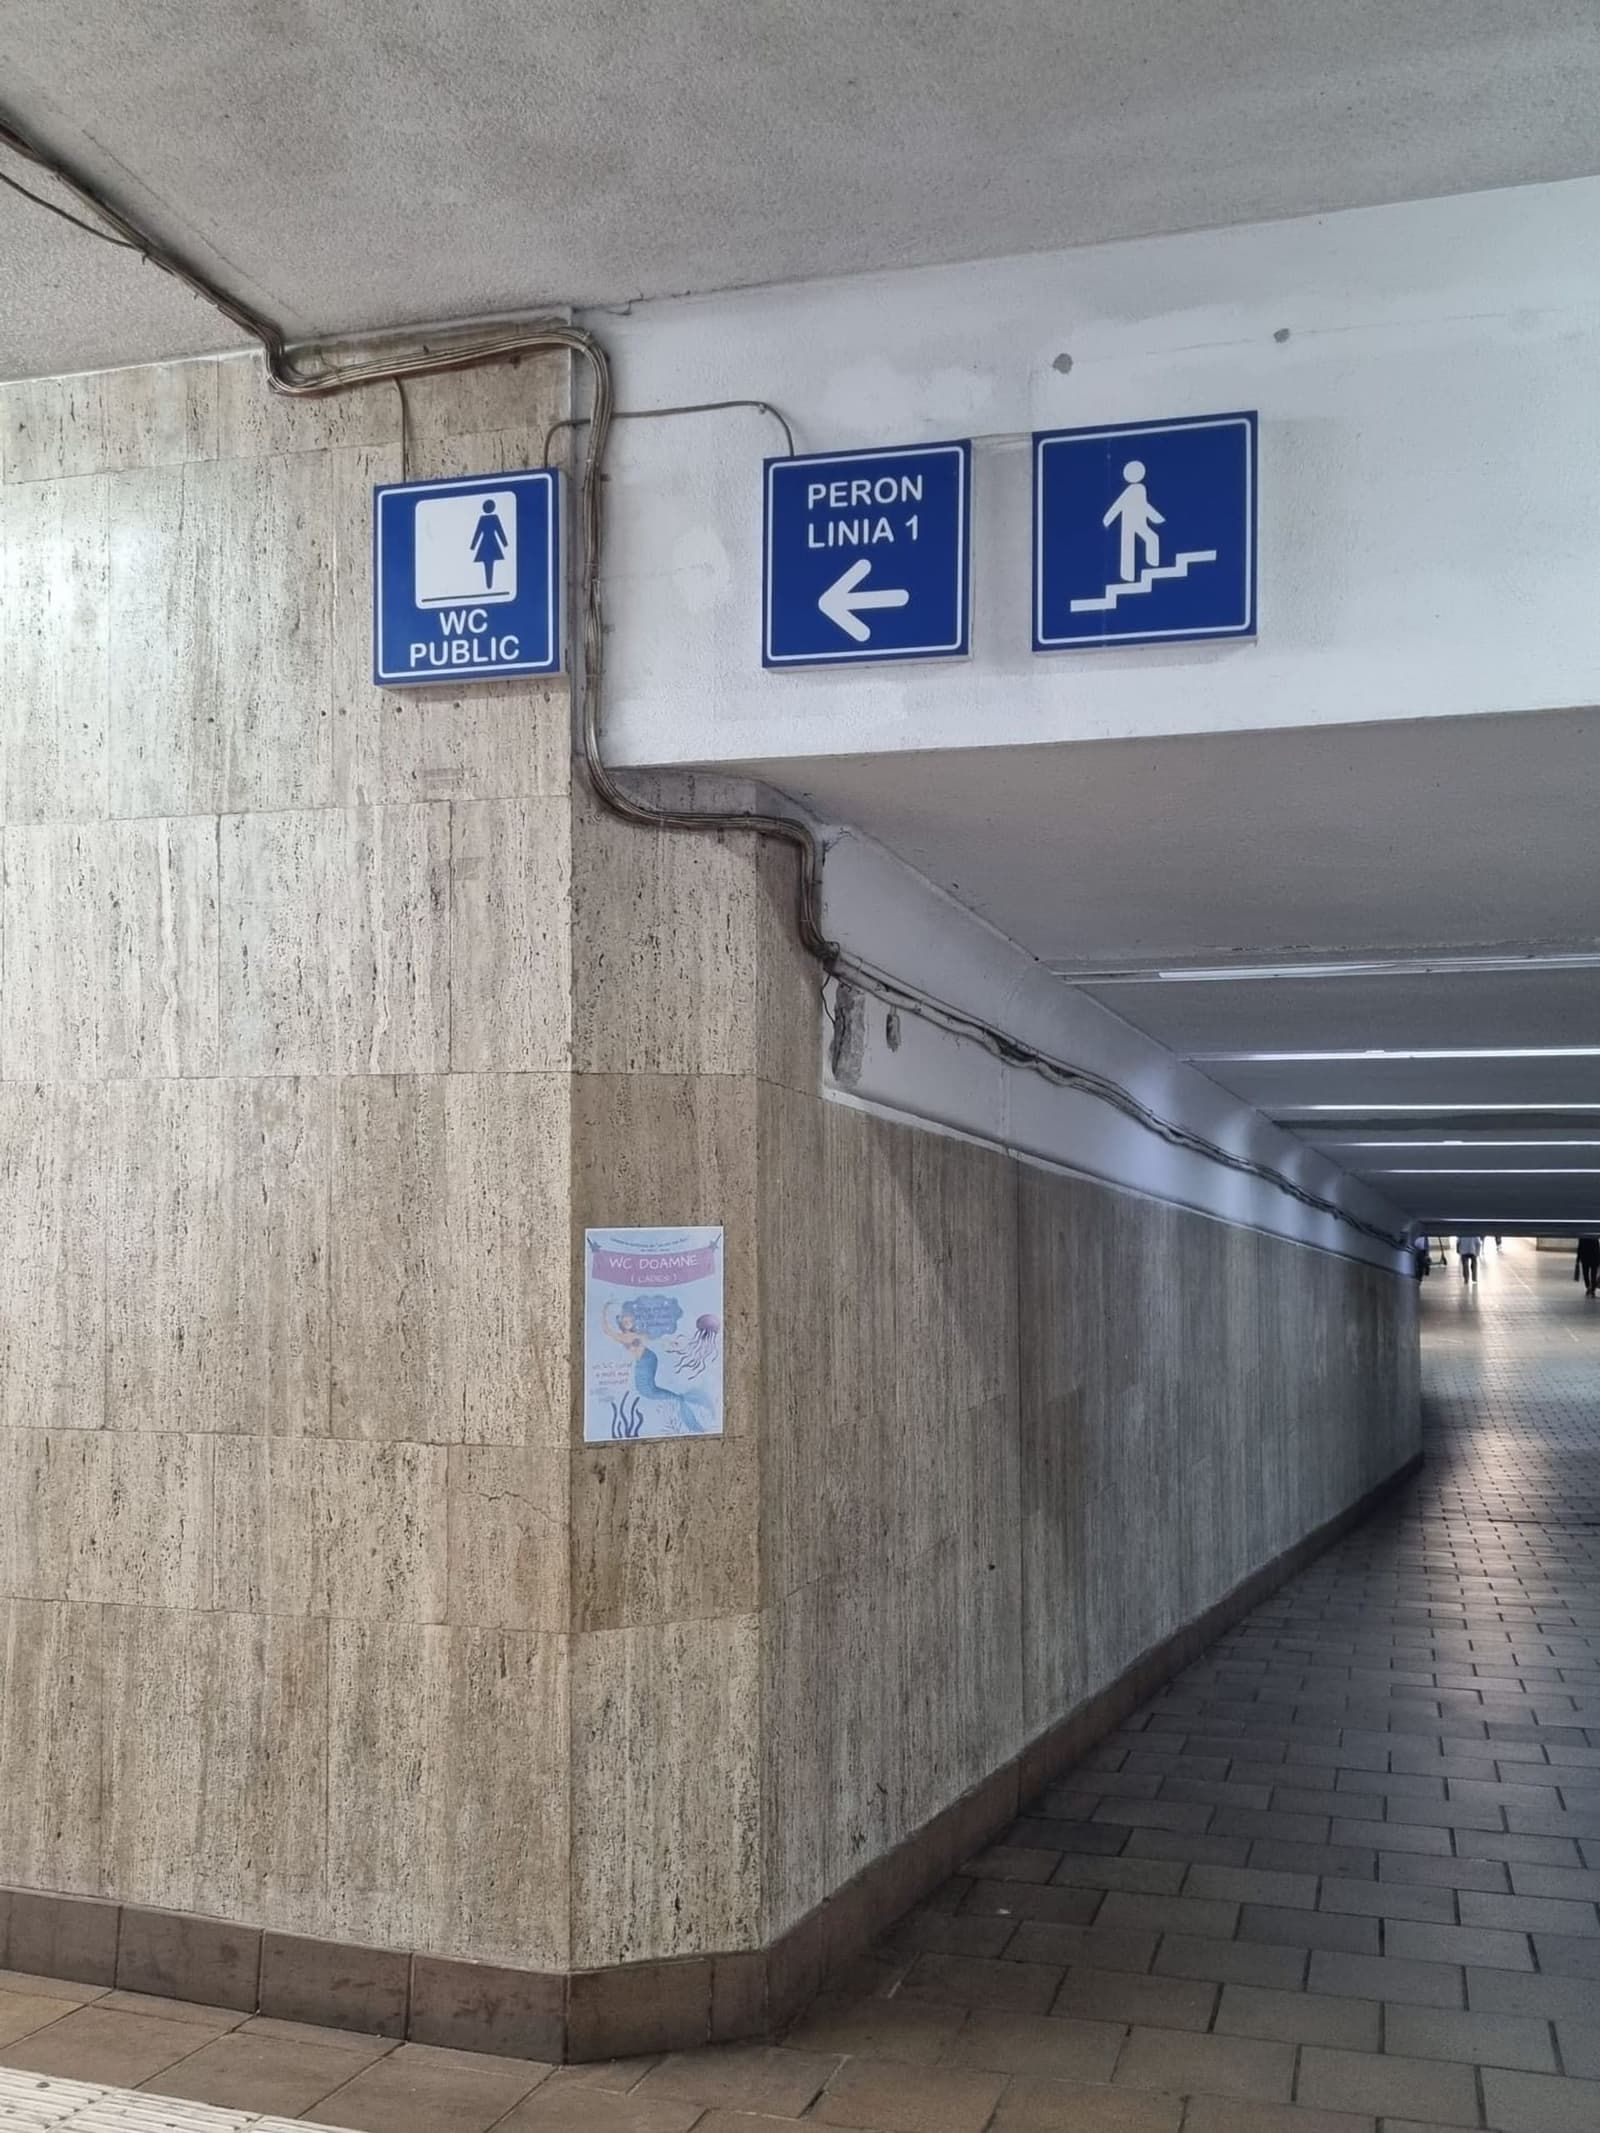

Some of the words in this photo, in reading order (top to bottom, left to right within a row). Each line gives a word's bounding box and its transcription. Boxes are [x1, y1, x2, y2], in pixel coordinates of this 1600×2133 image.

[808, 475, 922, 510] PERON
[808, 517, 894, 548] LINIA
[905, 514, 918, 541] 1
[440, 608, 488, 636] WC
[410, 635, 519, 667] PUBLIC
[609, 1256, 633, 1269] WC
[639, 1255, 697, 1269] DOAMNE
